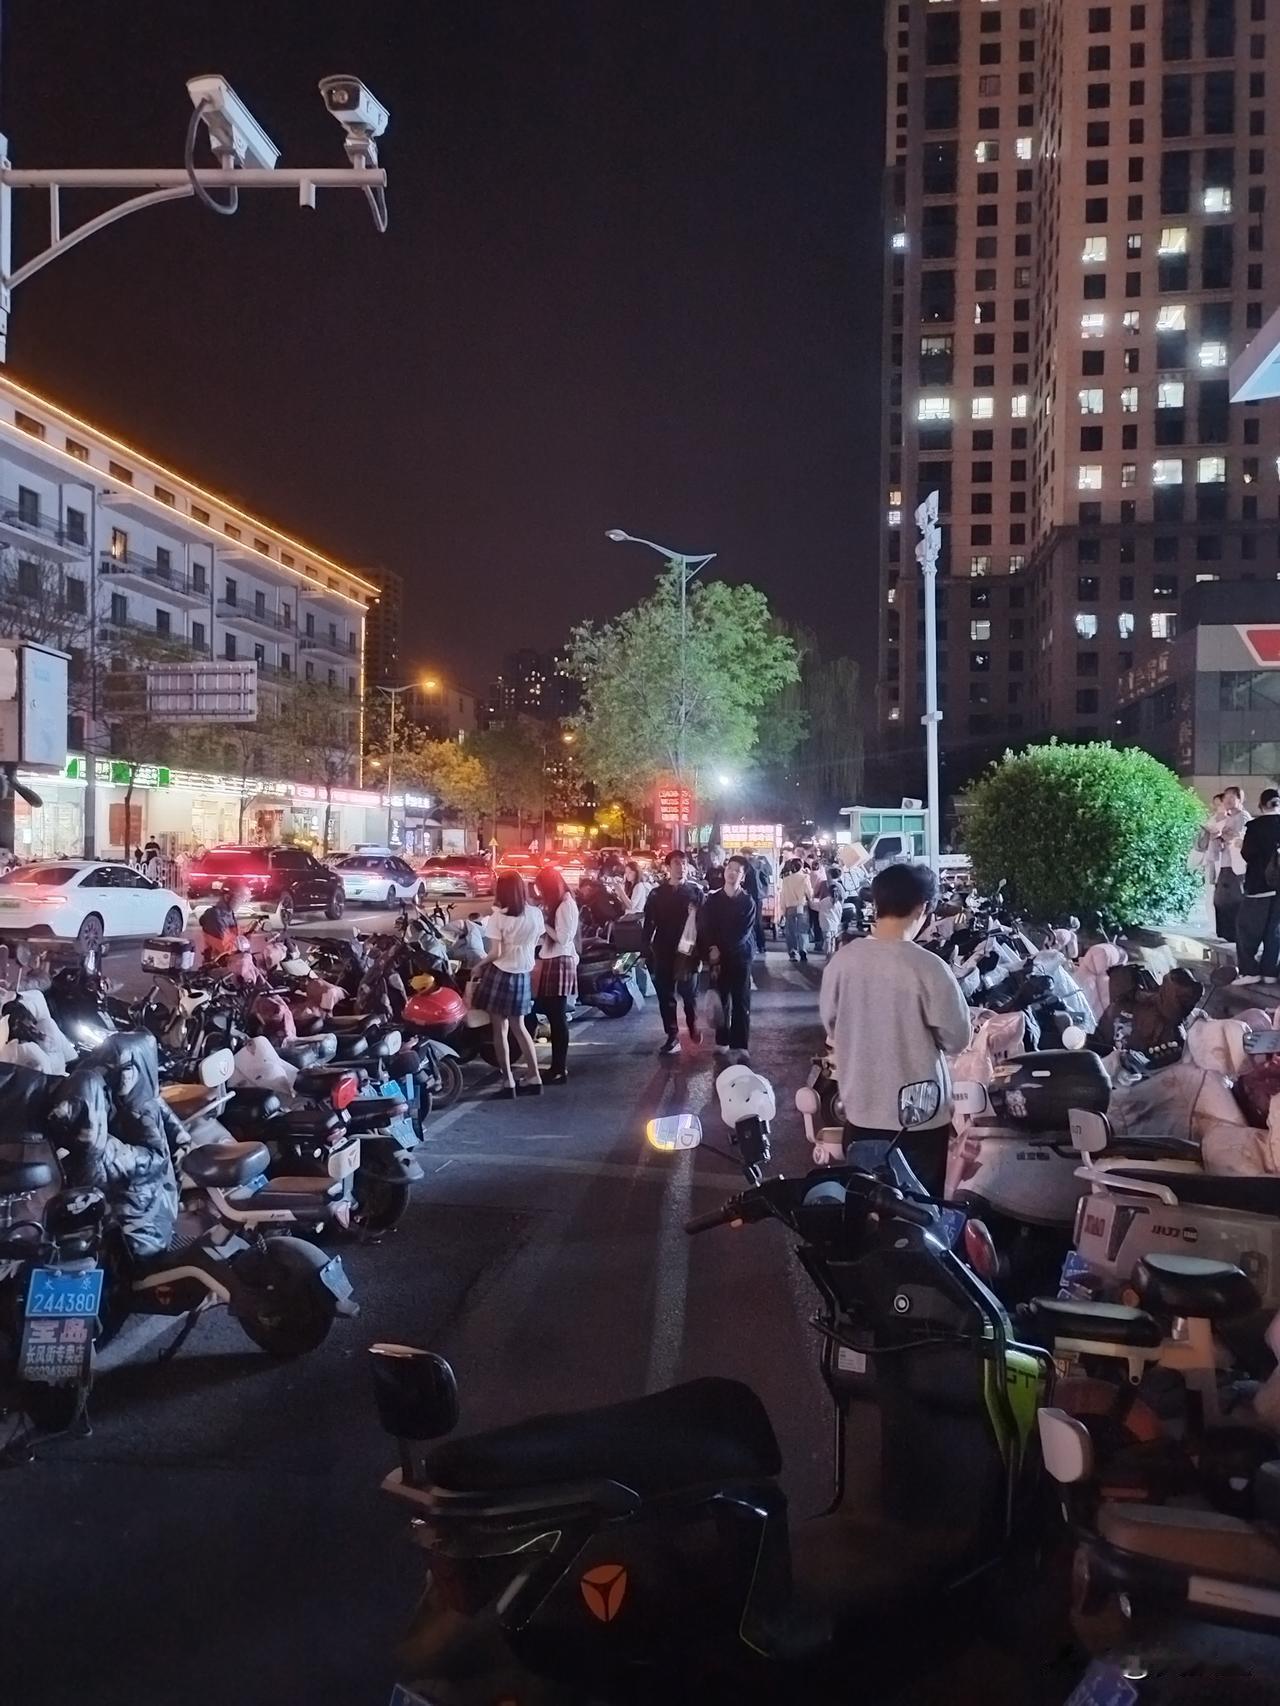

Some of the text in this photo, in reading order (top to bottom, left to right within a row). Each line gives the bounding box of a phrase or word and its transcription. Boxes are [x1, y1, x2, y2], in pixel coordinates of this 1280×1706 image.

[31, 1293, 95, 1312] 244380
[28, 1317, 88, 1343] 宝岛
[25, 1344, 85, 1364] 长风街专卖店
